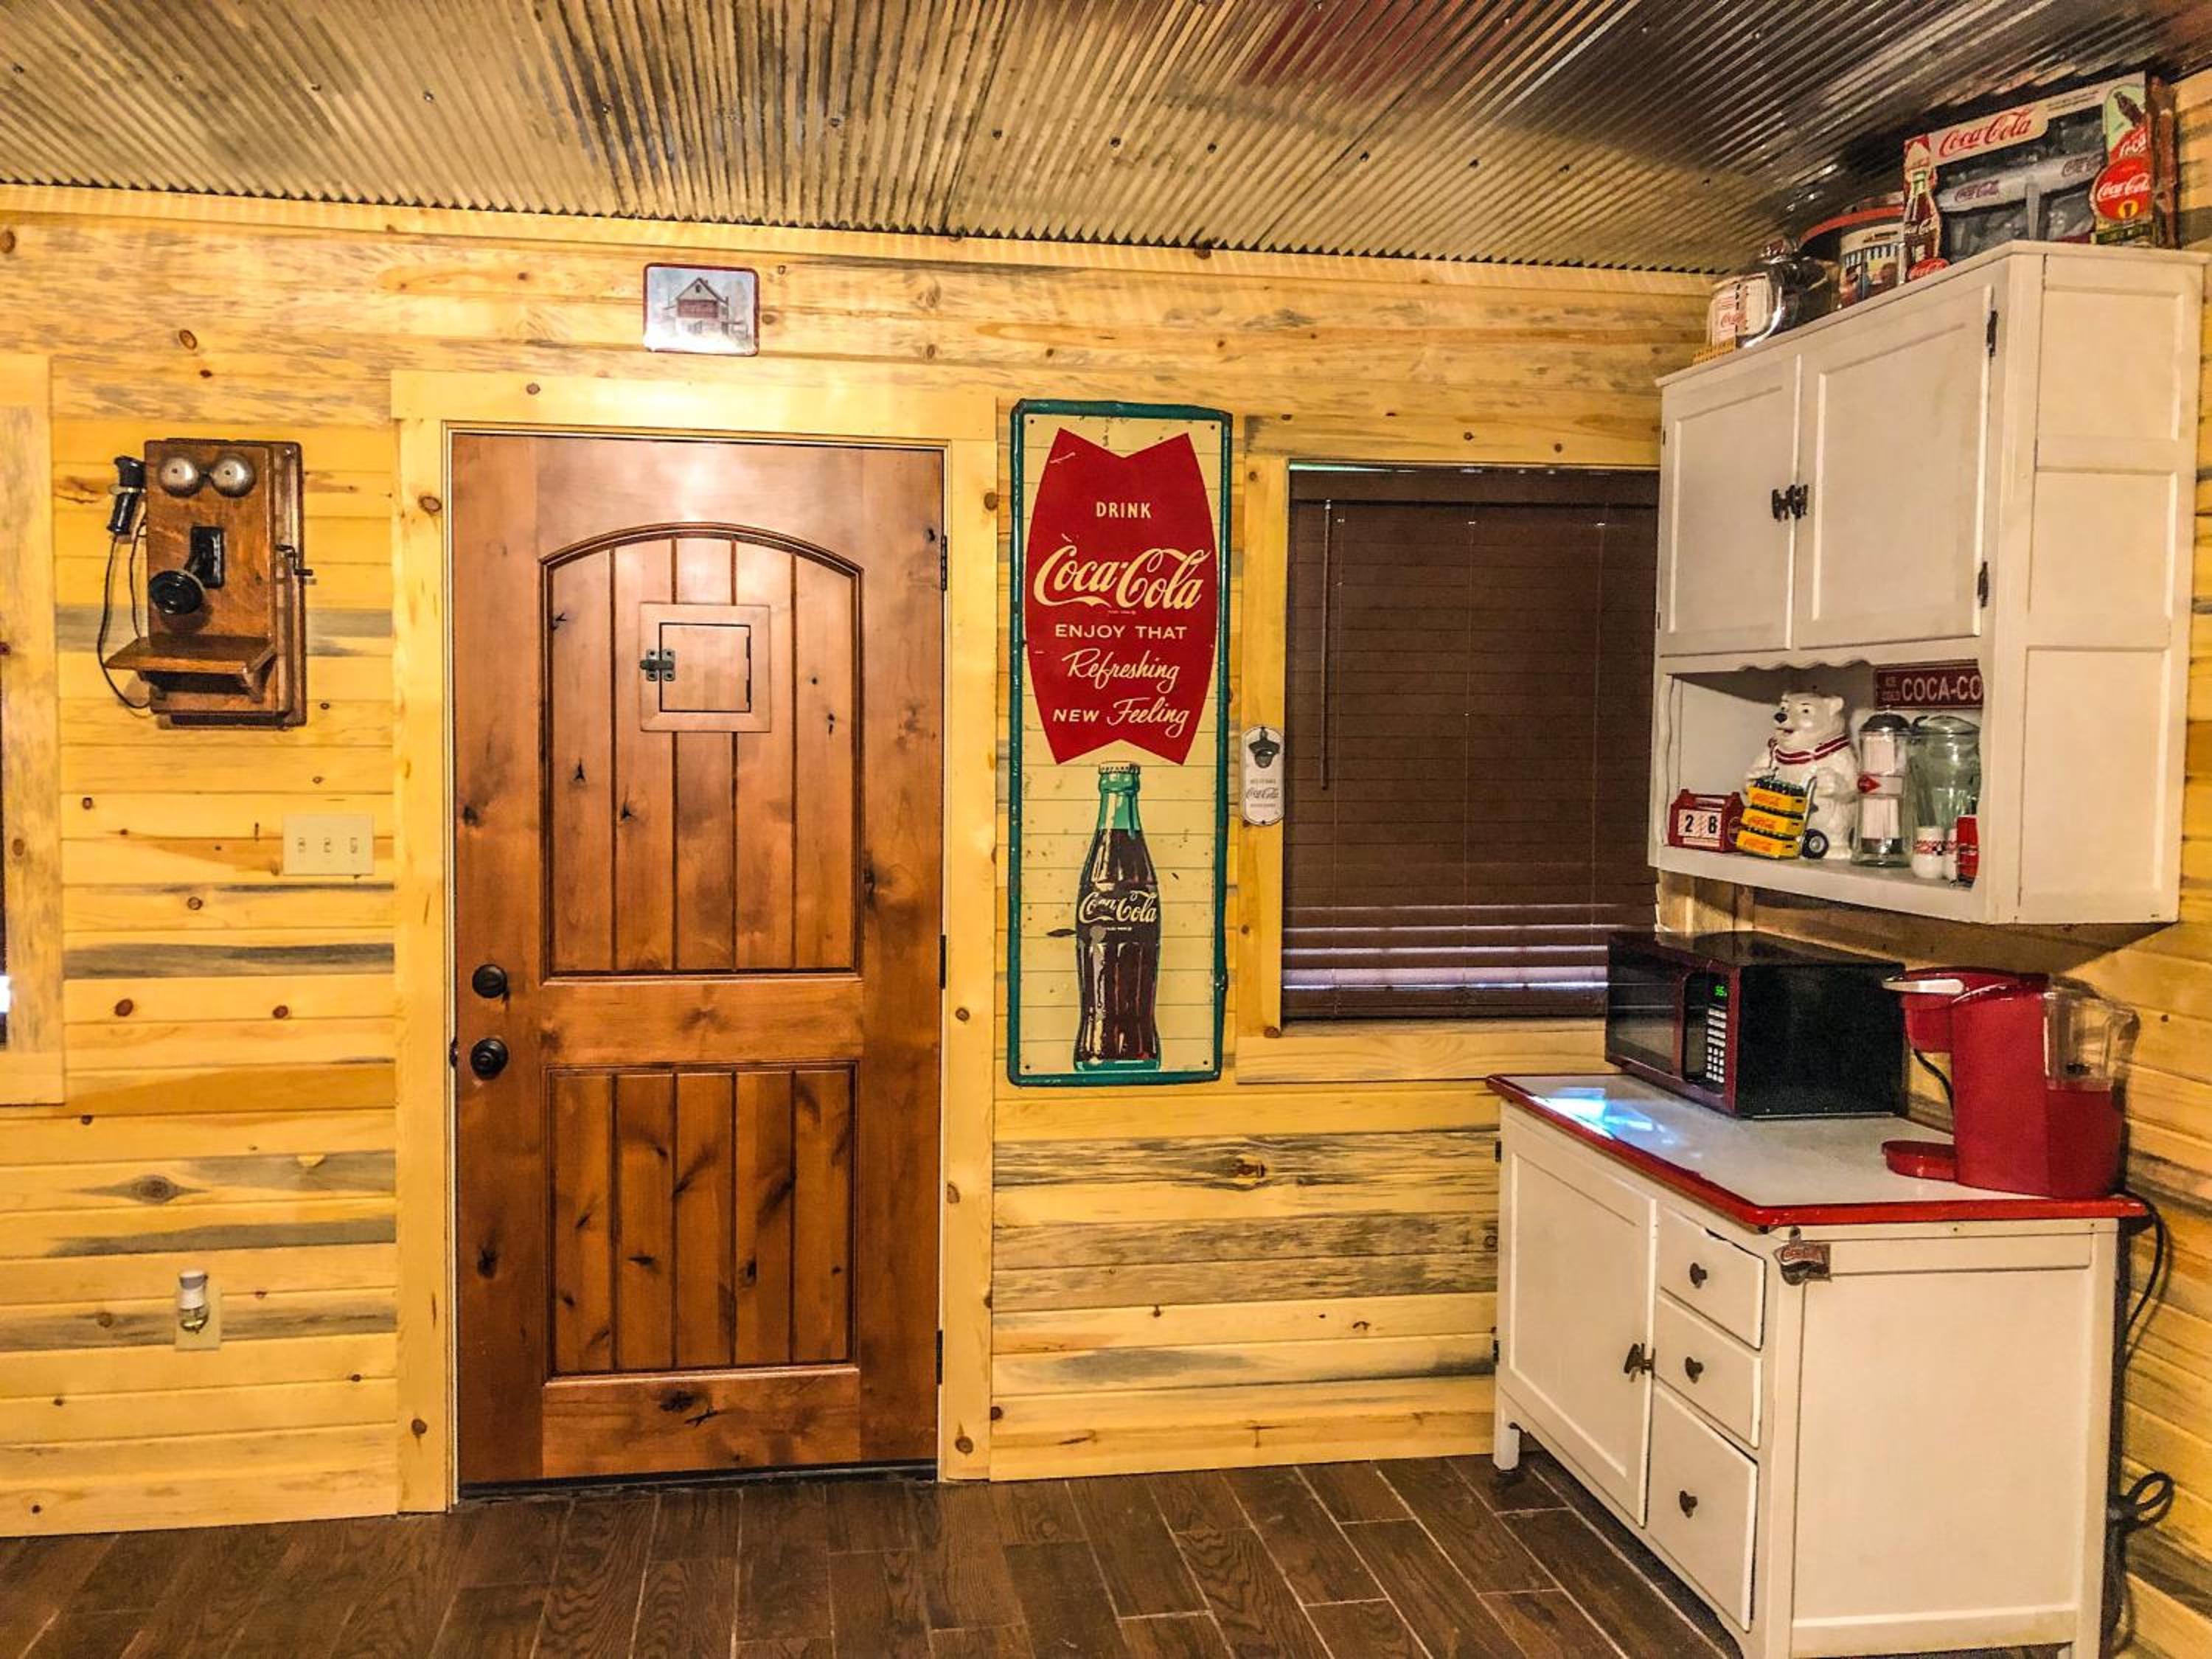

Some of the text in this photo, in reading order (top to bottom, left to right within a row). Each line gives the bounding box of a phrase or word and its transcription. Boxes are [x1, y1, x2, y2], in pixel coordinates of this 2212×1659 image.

[1938, 109, 2035, 159] Coca-Cola
[1096, 501, 1152, 518] DRINK
[1033, 545, 1212, 609] Coca-Cola
[1054, 624, 1188, 640] ENJOY THAT
[1061, 647, 1180, 694] Refreshing
[1052, 696, 1191, 738] NEW Feeling
[1079, 889, 1158, 924] Coca-Cola
